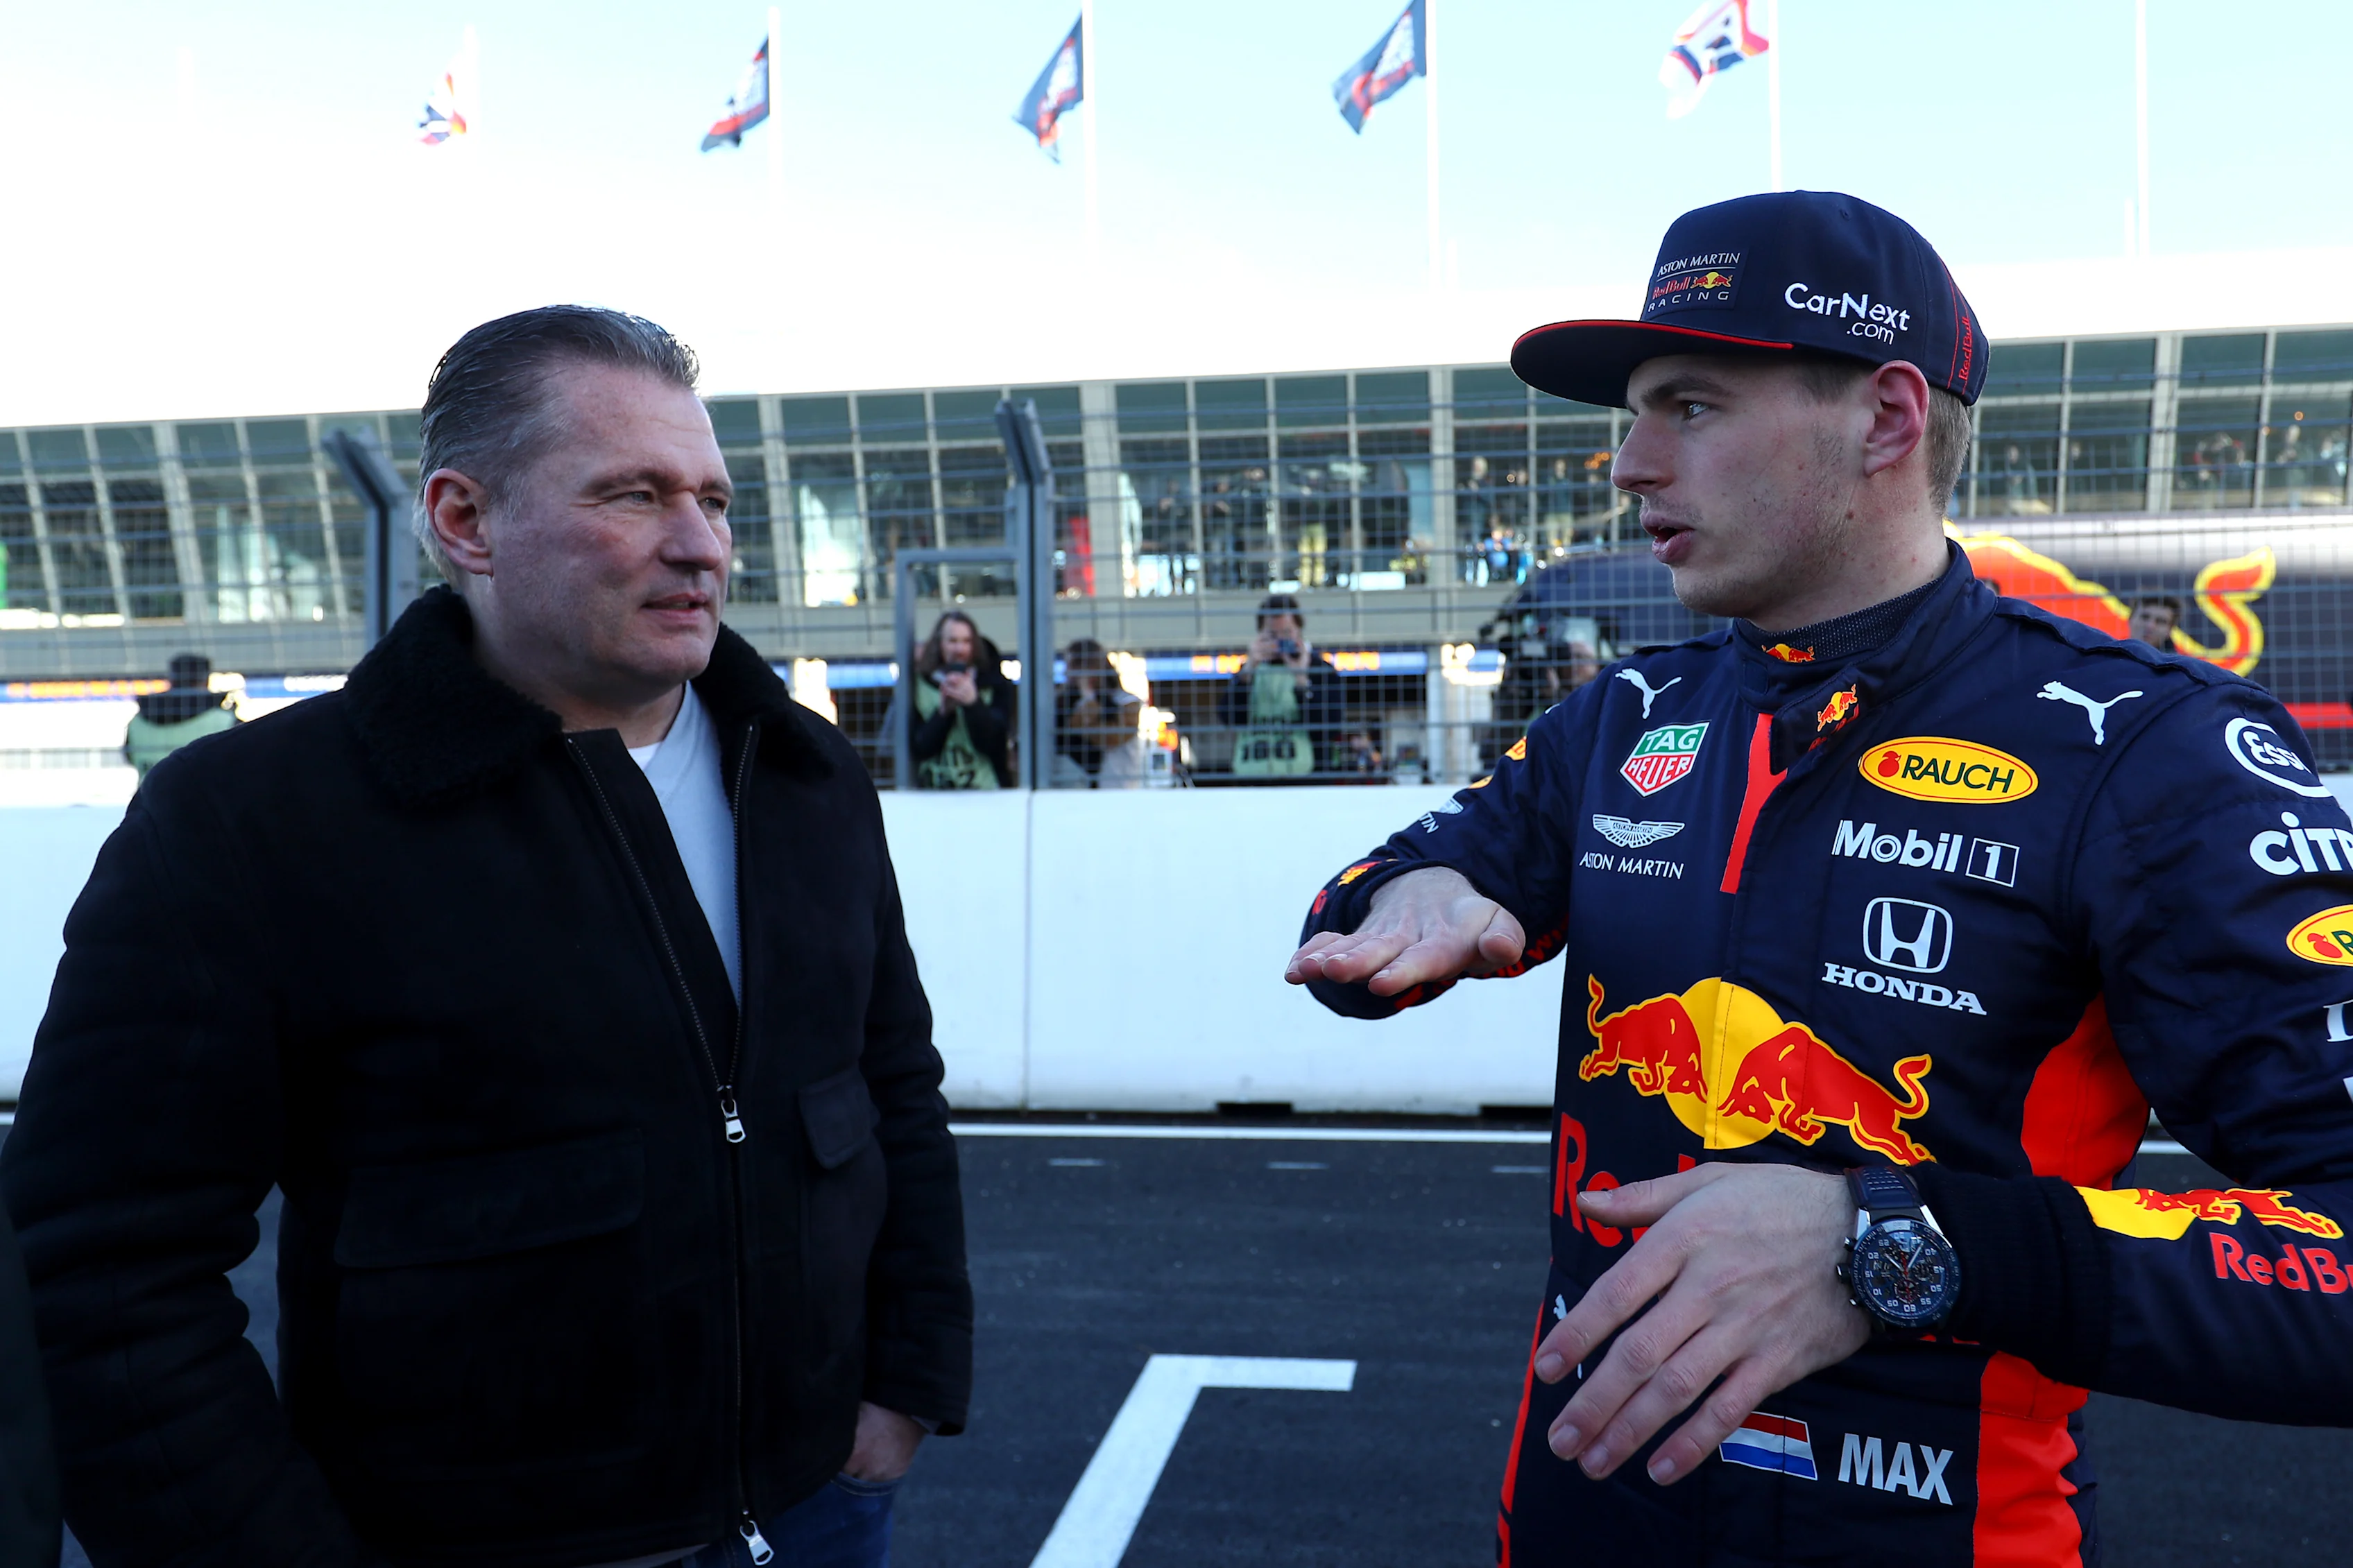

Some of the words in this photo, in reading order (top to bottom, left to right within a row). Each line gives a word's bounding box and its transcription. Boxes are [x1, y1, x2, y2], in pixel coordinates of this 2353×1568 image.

[1657, 258, 1688, 277] ASTON
[1690, 252, 1740, 267] MARTIN
[1648, 291, 1729, 312] RACING
[1784, 282, 1910, 331] CarNext
[1847, 322, 1894, 345] .com
[1644, 729, 1699, 752] TAG
[1627, 757, 1691, 790] HEUER
[1901, 755, 2014, 793] RAUCH
[1831, 819, 1963, 872] Mobil
[1579, 852, 1614, 871] ASTON
[1618, 856, 1684, 879] MARTIN
[1822, 962, 1987, 1015] HONDA
[1838, 1432, 1953, 1506] MAX
